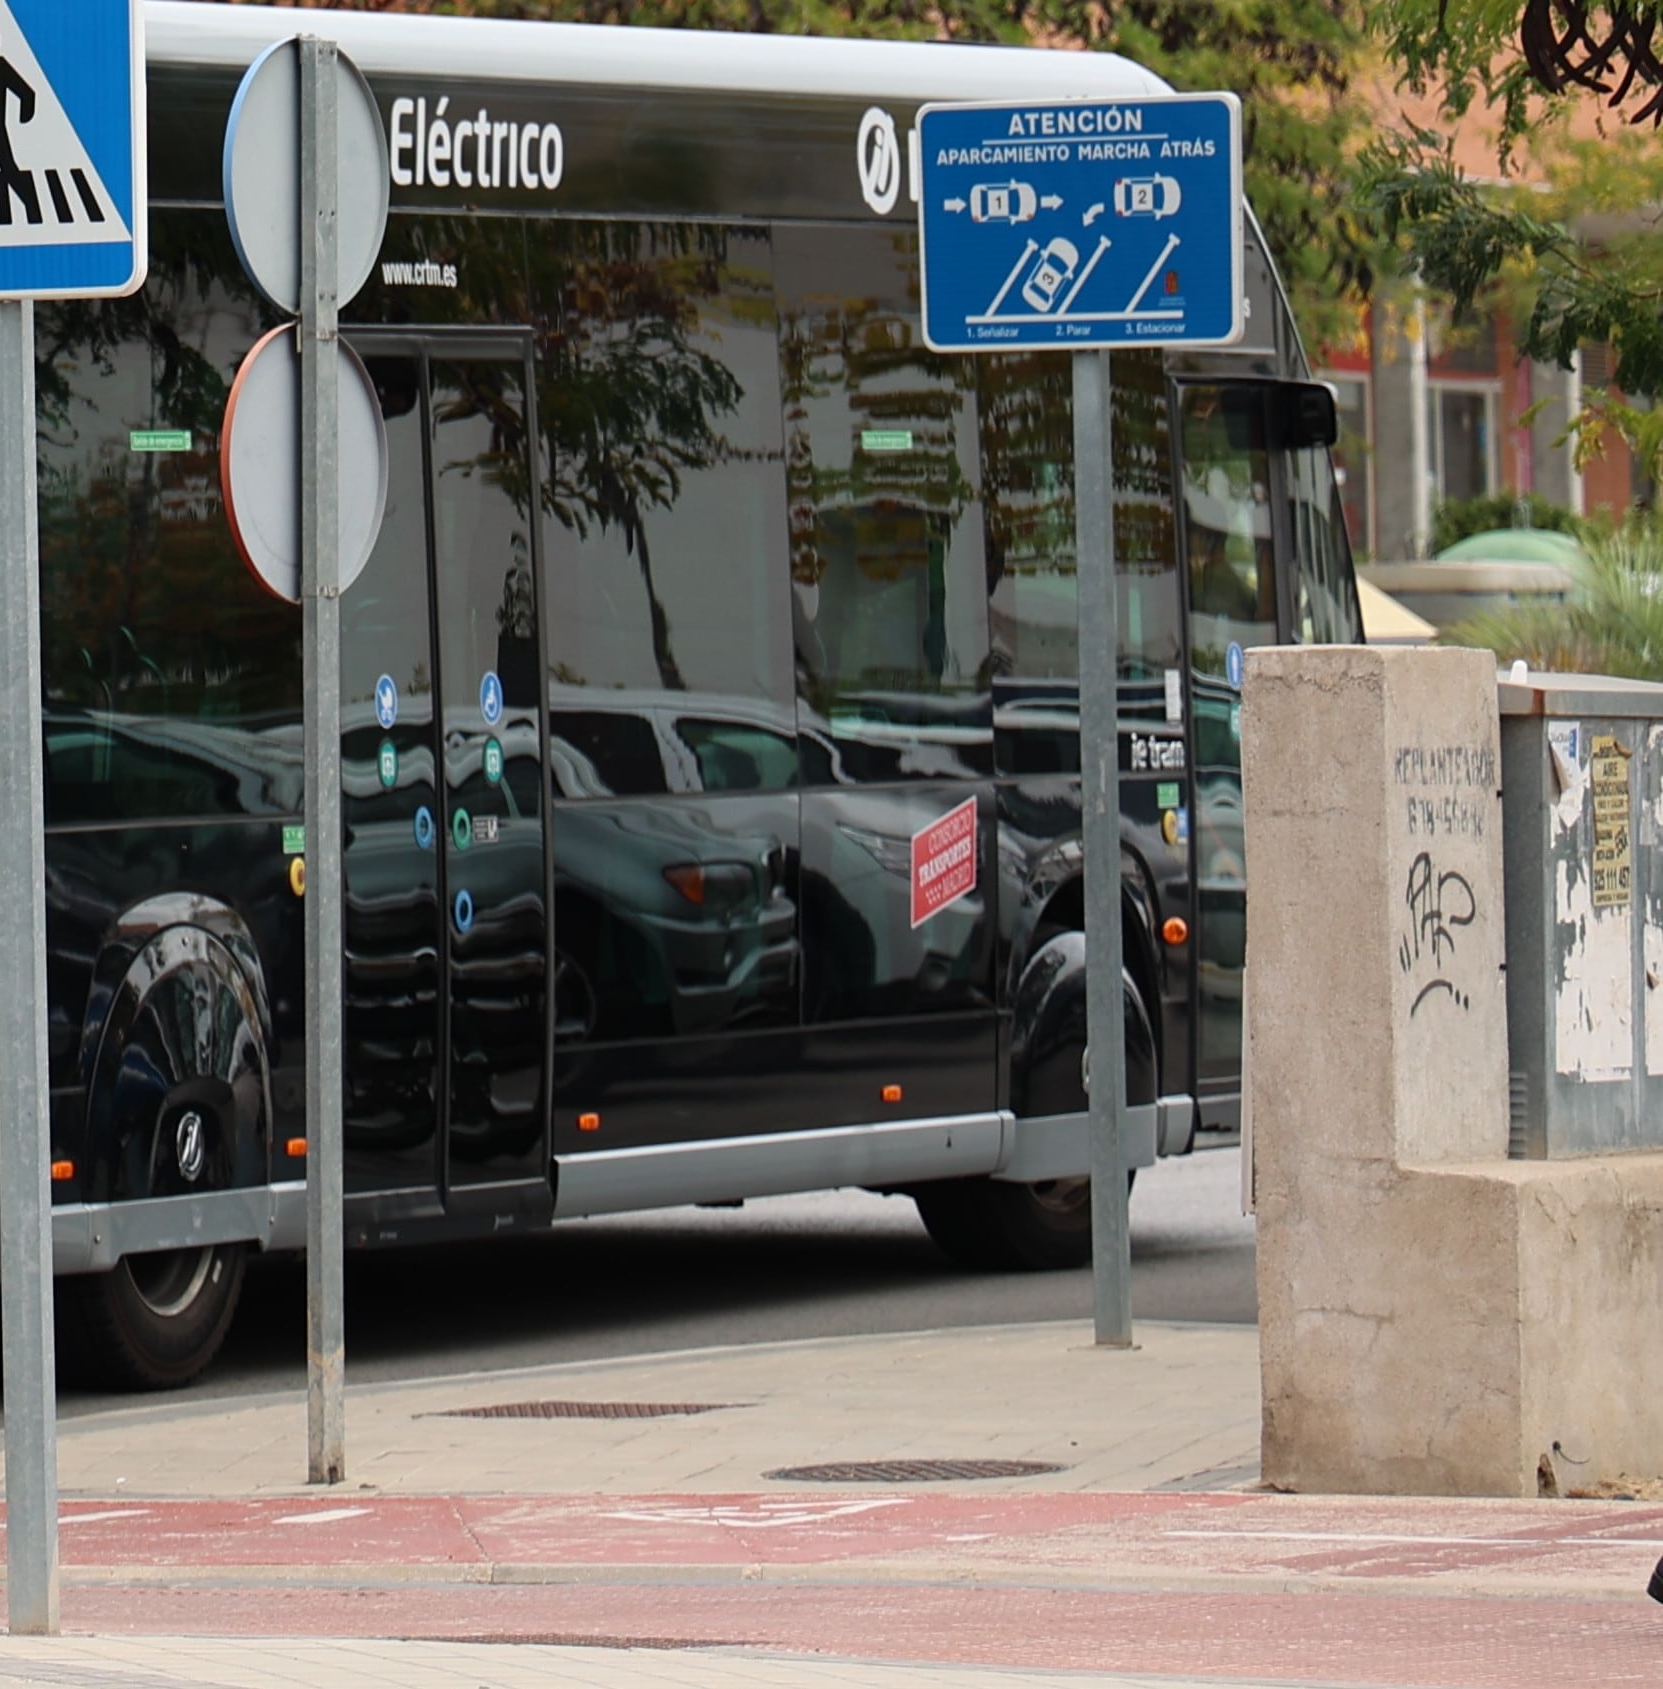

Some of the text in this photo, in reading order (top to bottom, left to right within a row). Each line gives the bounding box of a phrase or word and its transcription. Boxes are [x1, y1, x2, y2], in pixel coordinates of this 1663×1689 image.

[1008, 104, 1142, 136] ATENCIÓN
[391, 96, 563, 189] Eléctrico
[936, 136, 1215, 165] APARCAMIENTO MARCHA ATRÁS
[995, 195, 1002, 211] 1
[1137, 189, 1147, 205] 2
[382, 258, 457, 288] www.crtm.es
[1042, 273, 1054, 286] 3
[977, 326, 1019, 338] Señalizar
[1067, 324, 1091, 336] Parar
[1136, 322, 1186, 334] Estacionar
[1148, 735, 1185, 769] tram
